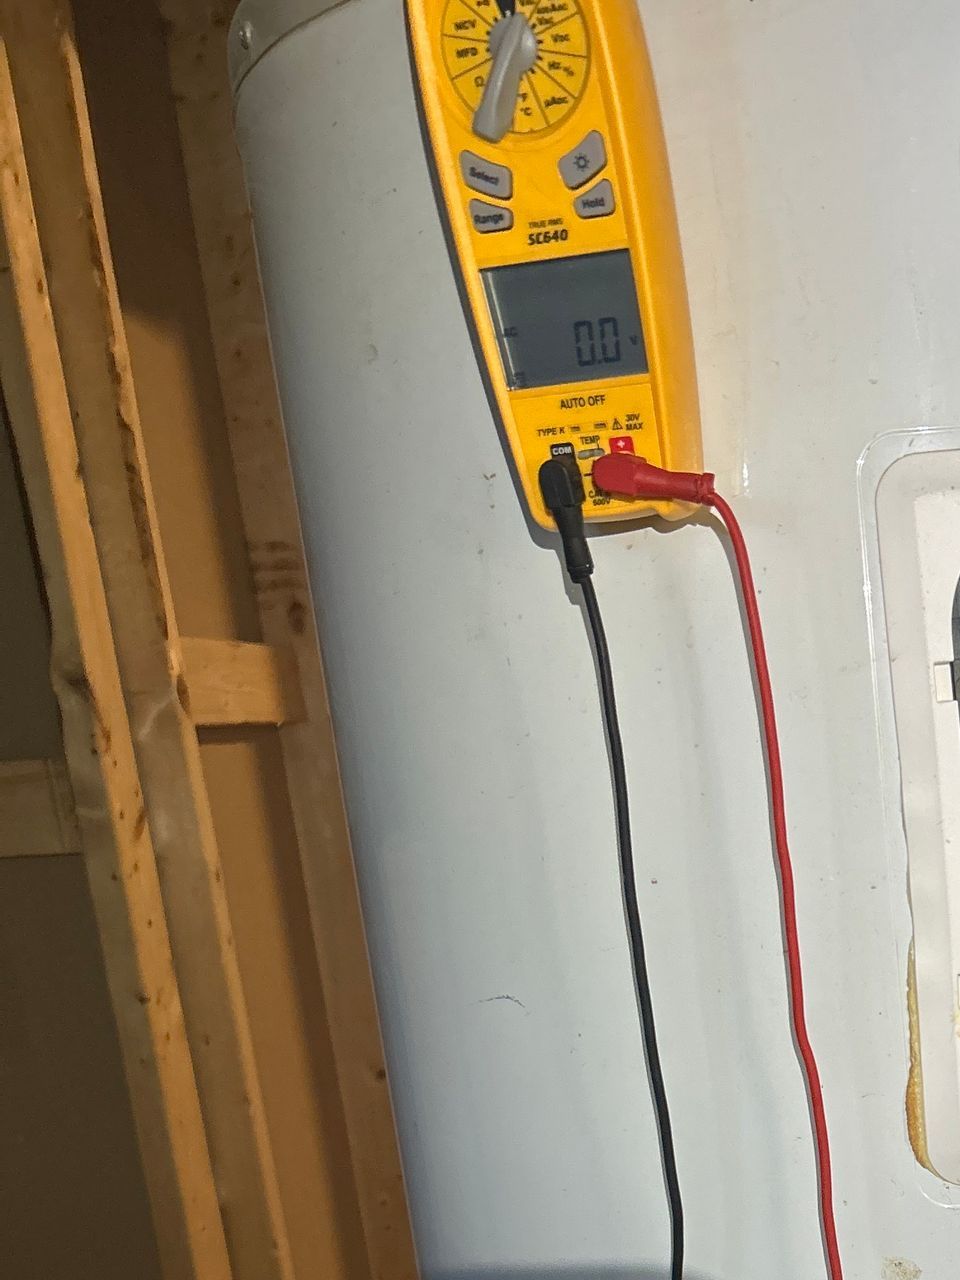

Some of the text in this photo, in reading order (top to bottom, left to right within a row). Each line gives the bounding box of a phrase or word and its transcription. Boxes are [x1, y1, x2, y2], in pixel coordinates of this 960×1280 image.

[469, 166, 499, 186] Select
[583, 197, 605, 209] Hold
[474, 213, 504, 225] Range
[528, 229, 568, 245] SC640
[560, 395, 605, 410] AUTO OFF
[626, 413, 640, 422] 30V
[537, 427, 557, 437] TYPE
[626, 422, 643, 431] MAX
[579, 435, 600, 445] TEMP
[552, 446, 572, 455] COM
